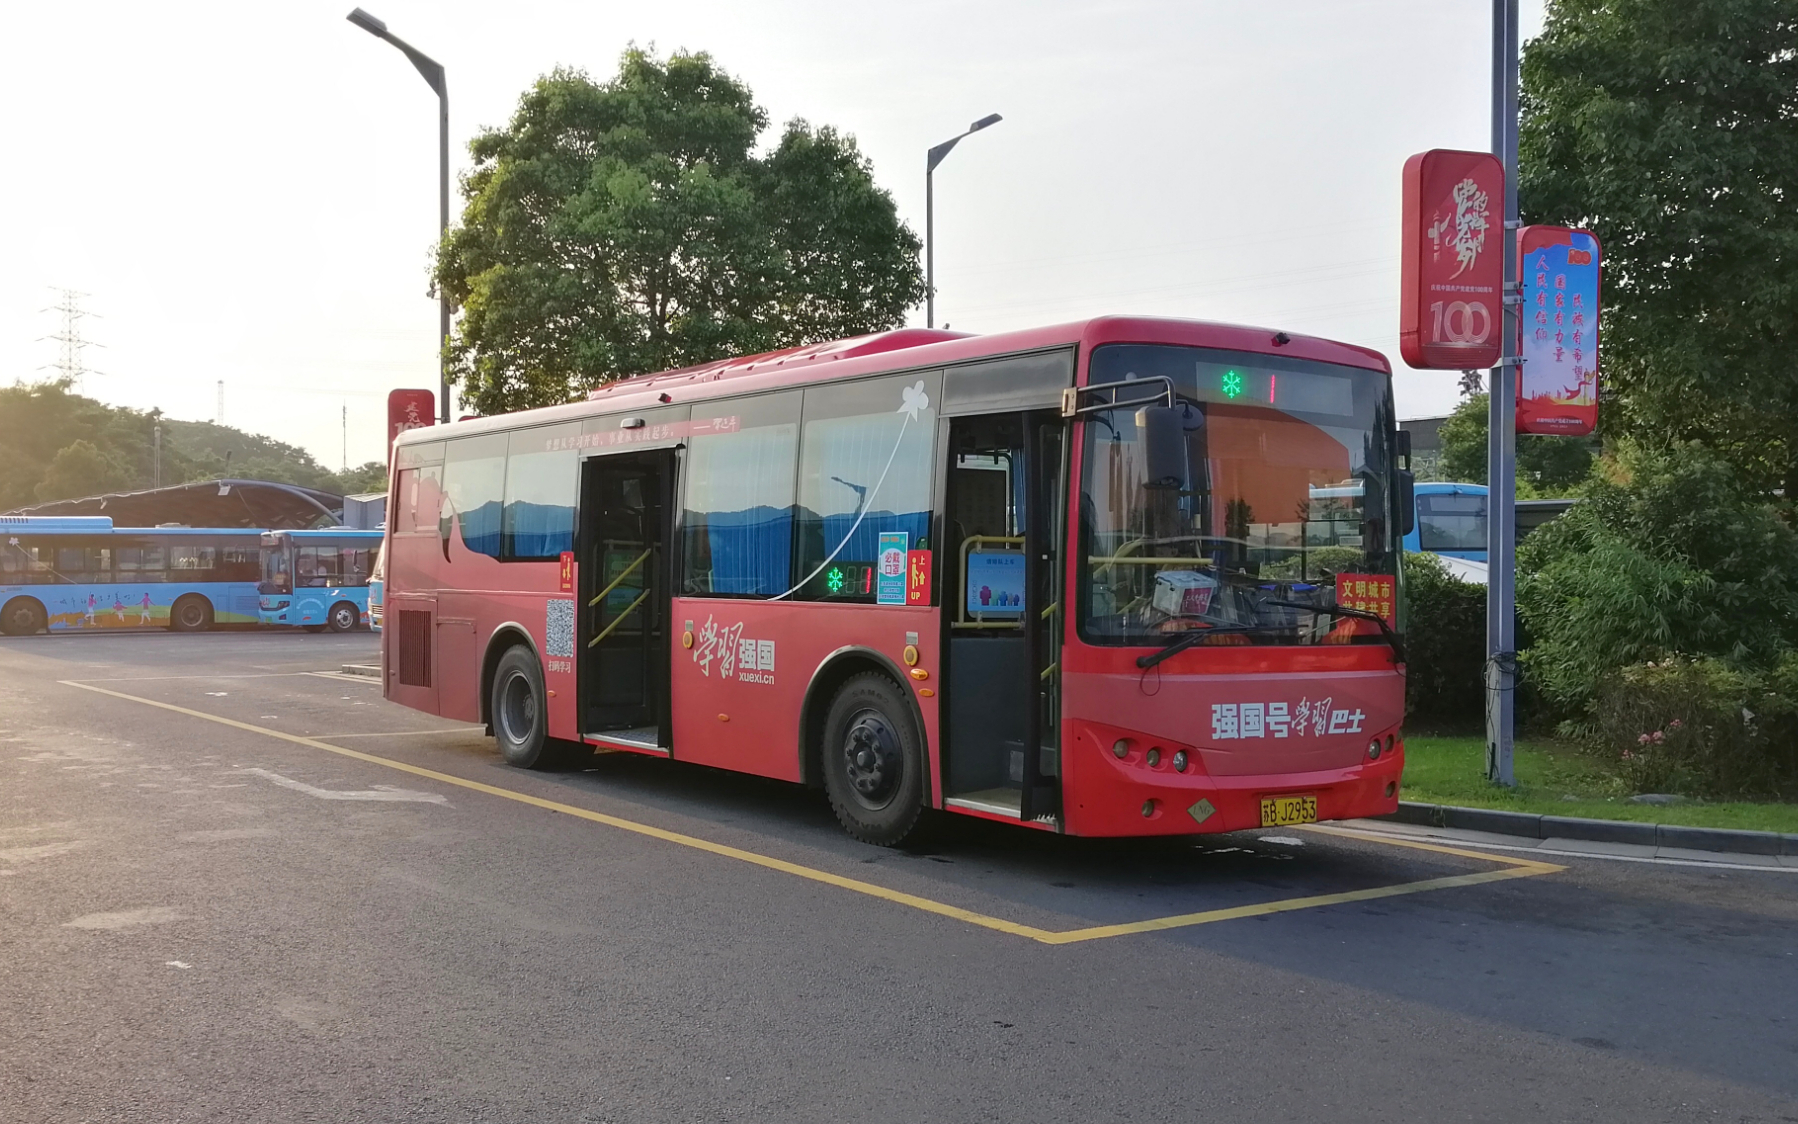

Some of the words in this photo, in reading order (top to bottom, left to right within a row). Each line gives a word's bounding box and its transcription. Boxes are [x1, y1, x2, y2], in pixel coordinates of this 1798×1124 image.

[1535, 254, 1550, 342] 人民有信仰
[1430, 300, 1491, 344] 100
[1553, 274, 1567, 363] 国家有力量
[1572, 293, 1585, 381] 民族有希望
[919, 555, 926, 566] 上
[910, 591, 921, 600] UP
[1342, 579, 1391, 599] 文明城市
[738, 670, 775, 685] xuexi.cn
[1193, 804, 1211, 816] LNG
